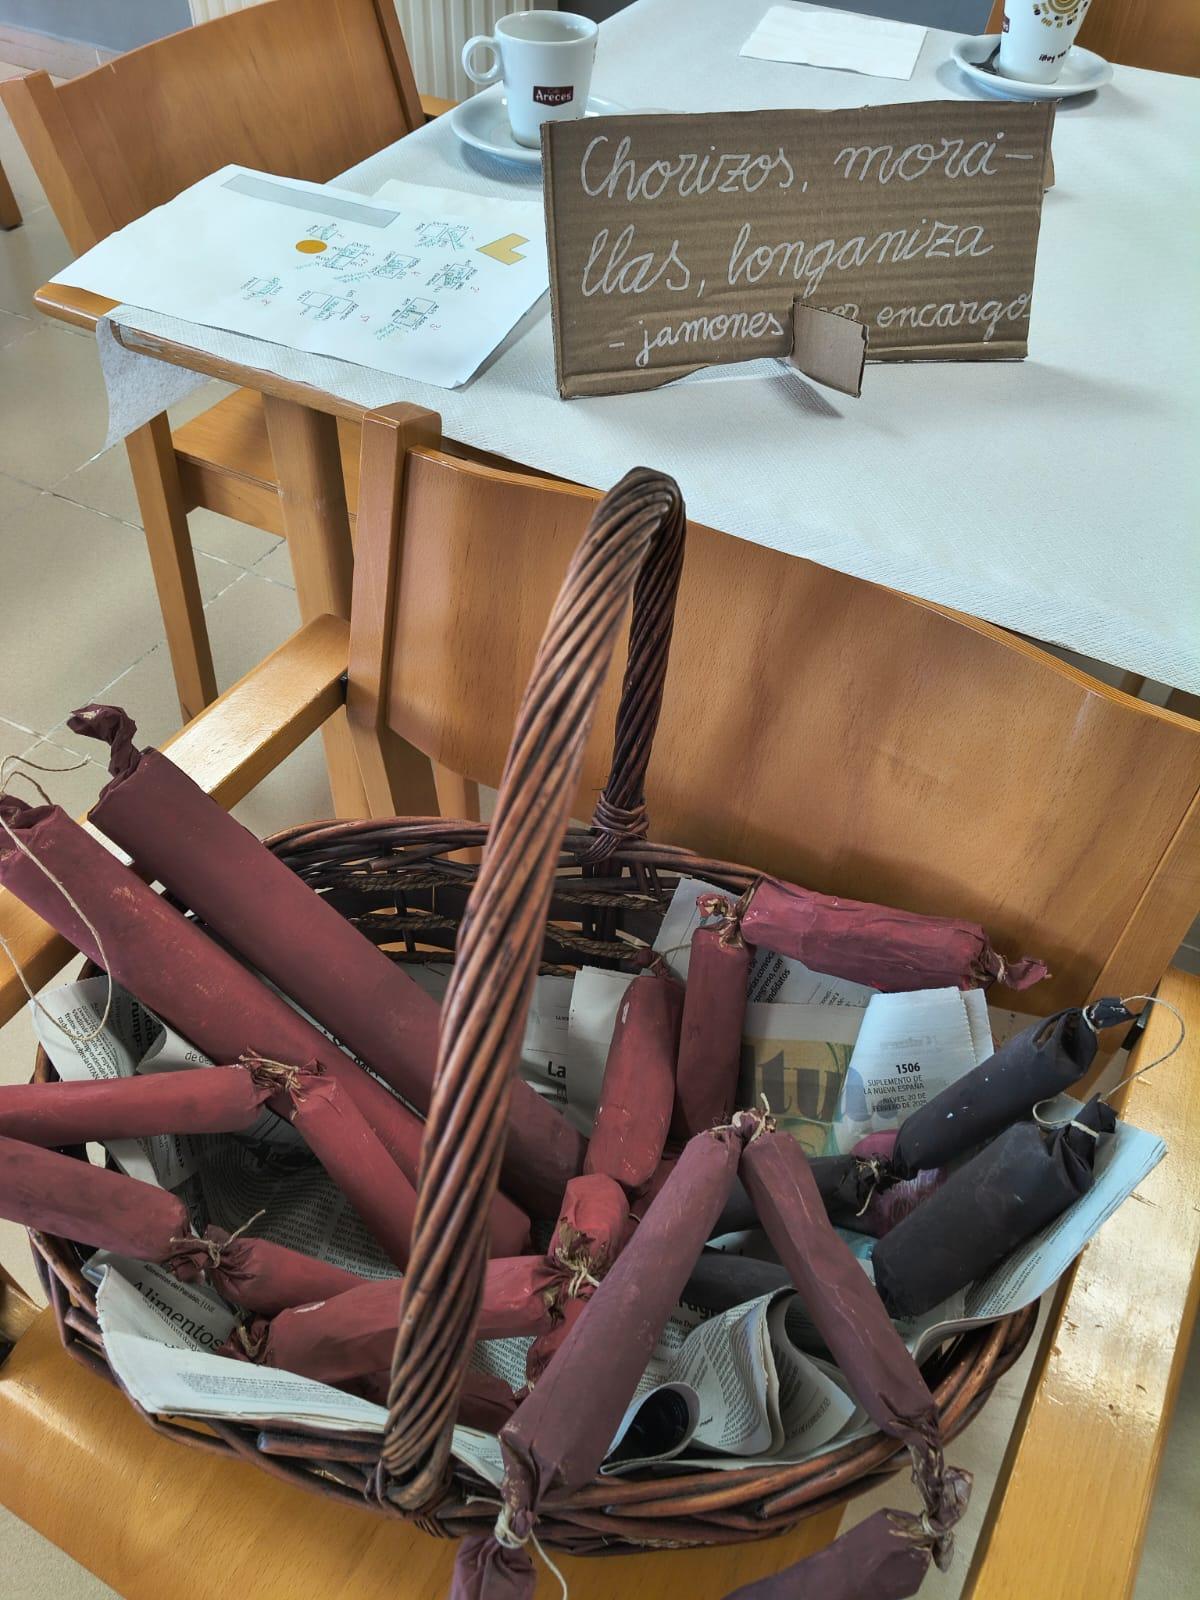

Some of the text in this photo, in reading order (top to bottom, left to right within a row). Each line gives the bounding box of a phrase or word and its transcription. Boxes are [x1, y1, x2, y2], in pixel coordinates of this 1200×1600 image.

[535, 89, 572, 101] Areces
[580, 136, 808, 200] Chorizos,
[581, 218, 995, 298] llas, longaniza
[634, 311, 785, 367] jamones
[772, 958, 784, 972] con
[896, 1062, 920, 1074] 1506
[867, 1074, 923, 1087] SUPLEMENTO DE
[873, 1086, 896, 1094] NUEVA
[897, 1082, 924, 1091] ESPAÑA
